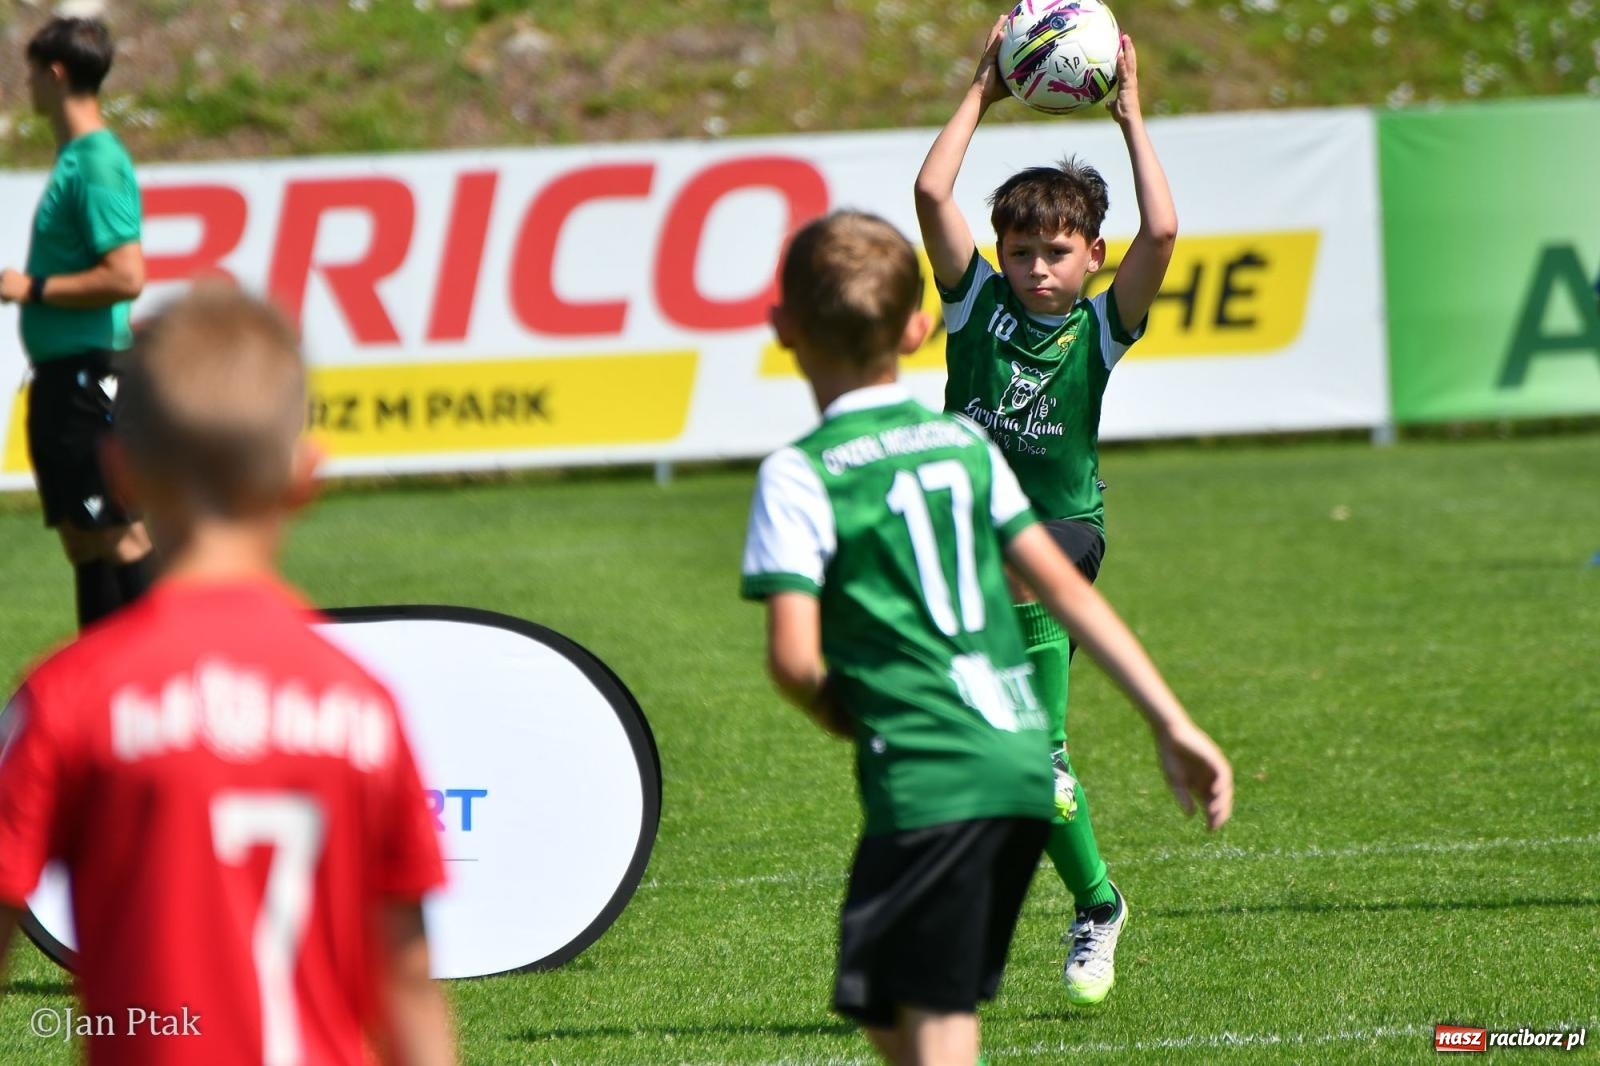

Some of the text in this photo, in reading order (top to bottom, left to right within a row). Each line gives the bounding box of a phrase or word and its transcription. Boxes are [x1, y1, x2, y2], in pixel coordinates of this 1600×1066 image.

[137, 154, 831, 346] BRICO
[987, 303, 1018, 342] 10
[307, 395, 357, 433] RZ
[426, 385, 554, 428] PARK
[1021, 413, 1065, 440] Lama
[885, 459, 986, 637] 17
[423, 789, 488, 832] RT
[209, 791, 327, 1066] 7
